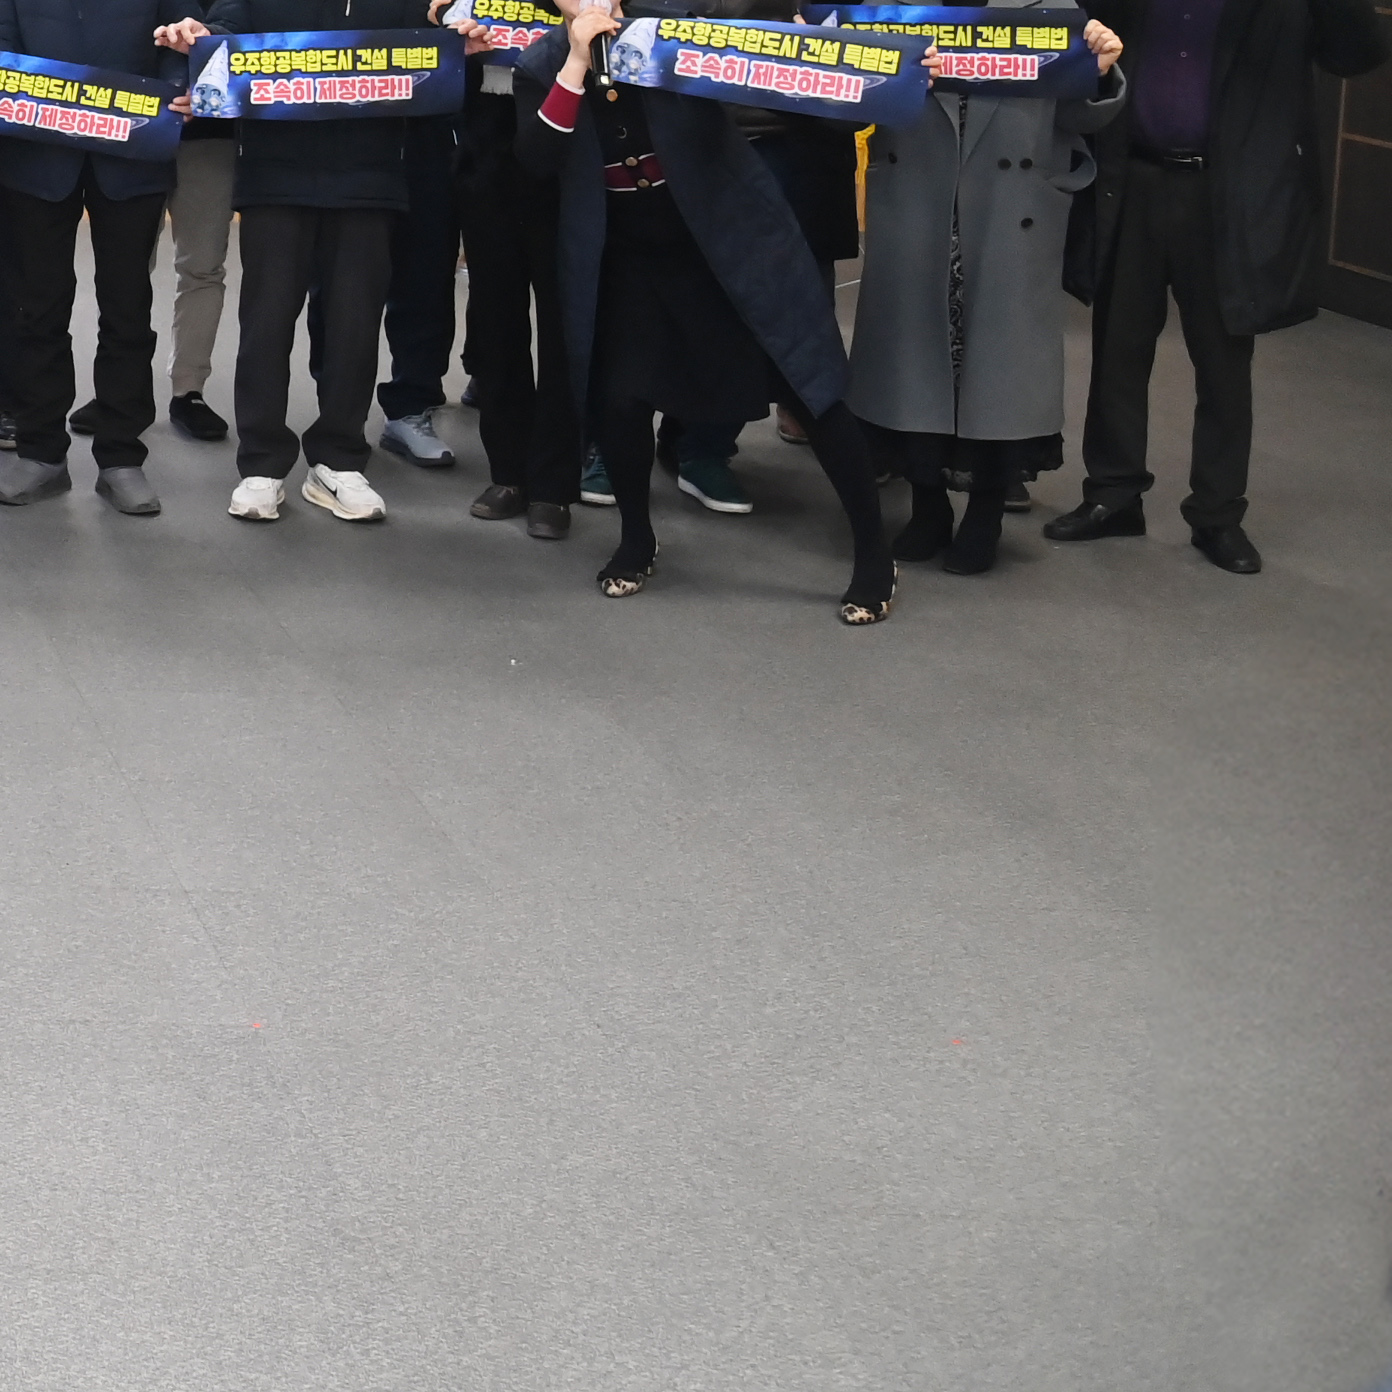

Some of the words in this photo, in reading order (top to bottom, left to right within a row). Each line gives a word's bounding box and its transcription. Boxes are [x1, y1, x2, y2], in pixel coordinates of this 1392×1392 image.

[658, 19, 801, 58] 우주항공복합도시
[802, 37, 841, 66] 건설
[843, 43, 901, 75] 특별법
[975, 25, 1012, 49] 건설
[1015, 26, 1069, 50] 특별법
[230, 49, 353, 75] 우주항공복합도시
[356, 48, 388, 71] 건설
[391, 46, 438, 70] 특별법
[674, 50, 749, 85] 조속히
[747, 61, 865, 102] 제정하라!!
[80, 84, 113, 109] 건설
[114, 90, 161, 117] 특별법
[250, 78, 314, 104] 조속히
[315, 75, 413, 104] 제정하라!!
[35, 105, 133, 141] 제정하라!!
